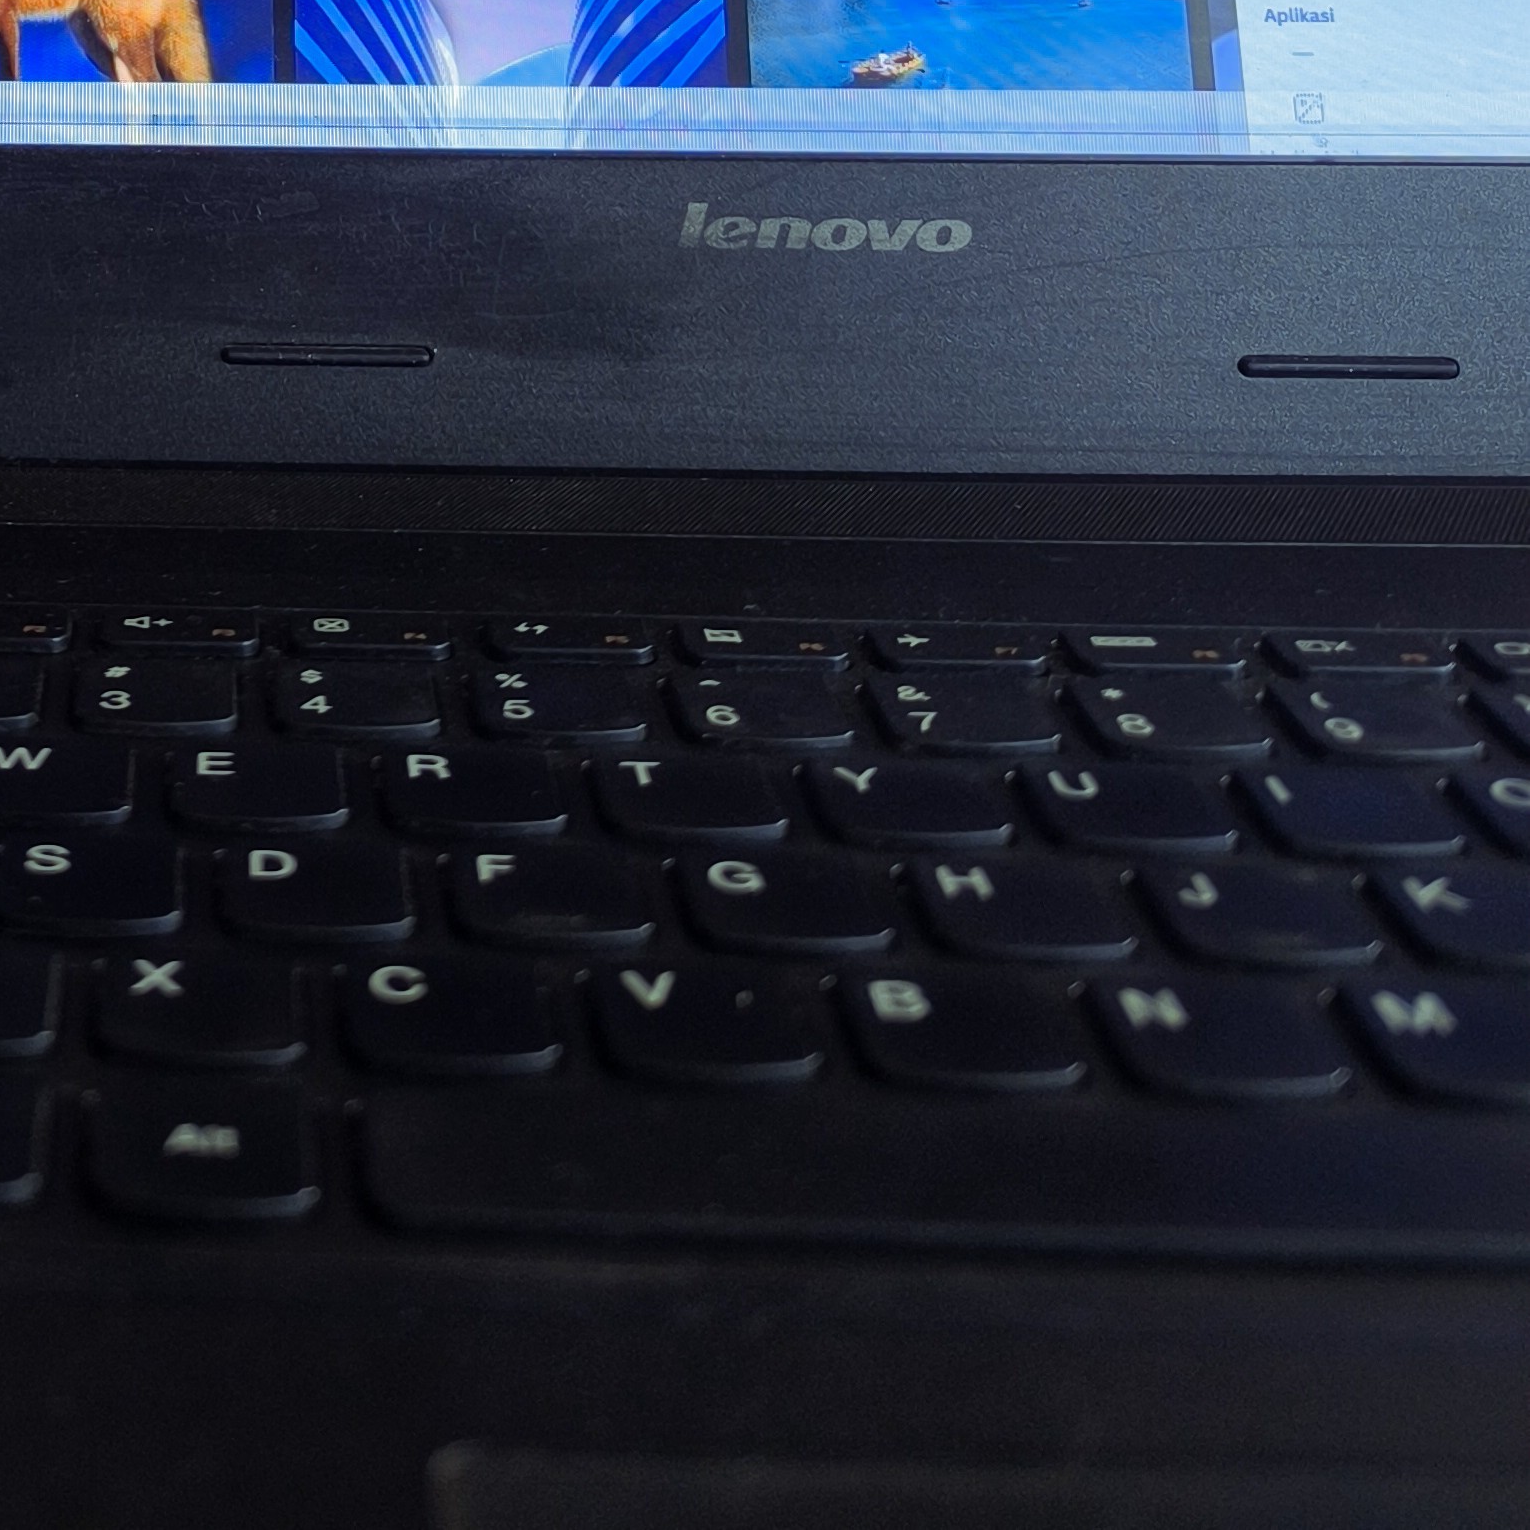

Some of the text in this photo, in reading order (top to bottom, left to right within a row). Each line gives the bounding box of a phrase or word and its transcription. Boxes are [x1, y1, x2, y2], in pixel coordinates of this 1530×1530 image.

[1263, 6, 1336, 26] Aplikasi
[677, 201, 973, 253] lenovo
[495, 672, 529, 689] %
[99, 690, 132, 710] 3
[299, 694, 333, 714] 4
[503, 699, 535, 720] 5
[706, 704, 740, 727] 6
[907, 711, 939, 734] 7
[1116, 712, 1156, 739] 8
[196, 751, 237, 776] E
[406, 753, 453, 780] R
[619, 760, 662, 786] T
[833, 766, 879, 794] Y
[1047, 770, 1099, 800] U
[23, 843, 72, 875] S
[248, 849, 299, 881] D
[476, 853, 517, 885] F
[706, 859, 767, 895] G
[935, 864, 995, 901] H
[1178, 871, 1220, 909] J
[1402, 875, 1471, 914] K
[129, 958, 185, 997] X
[367, 964, 429, 1005] C
[619, 970, 676, 1010] V
[867, 978, 932, 1021] B
